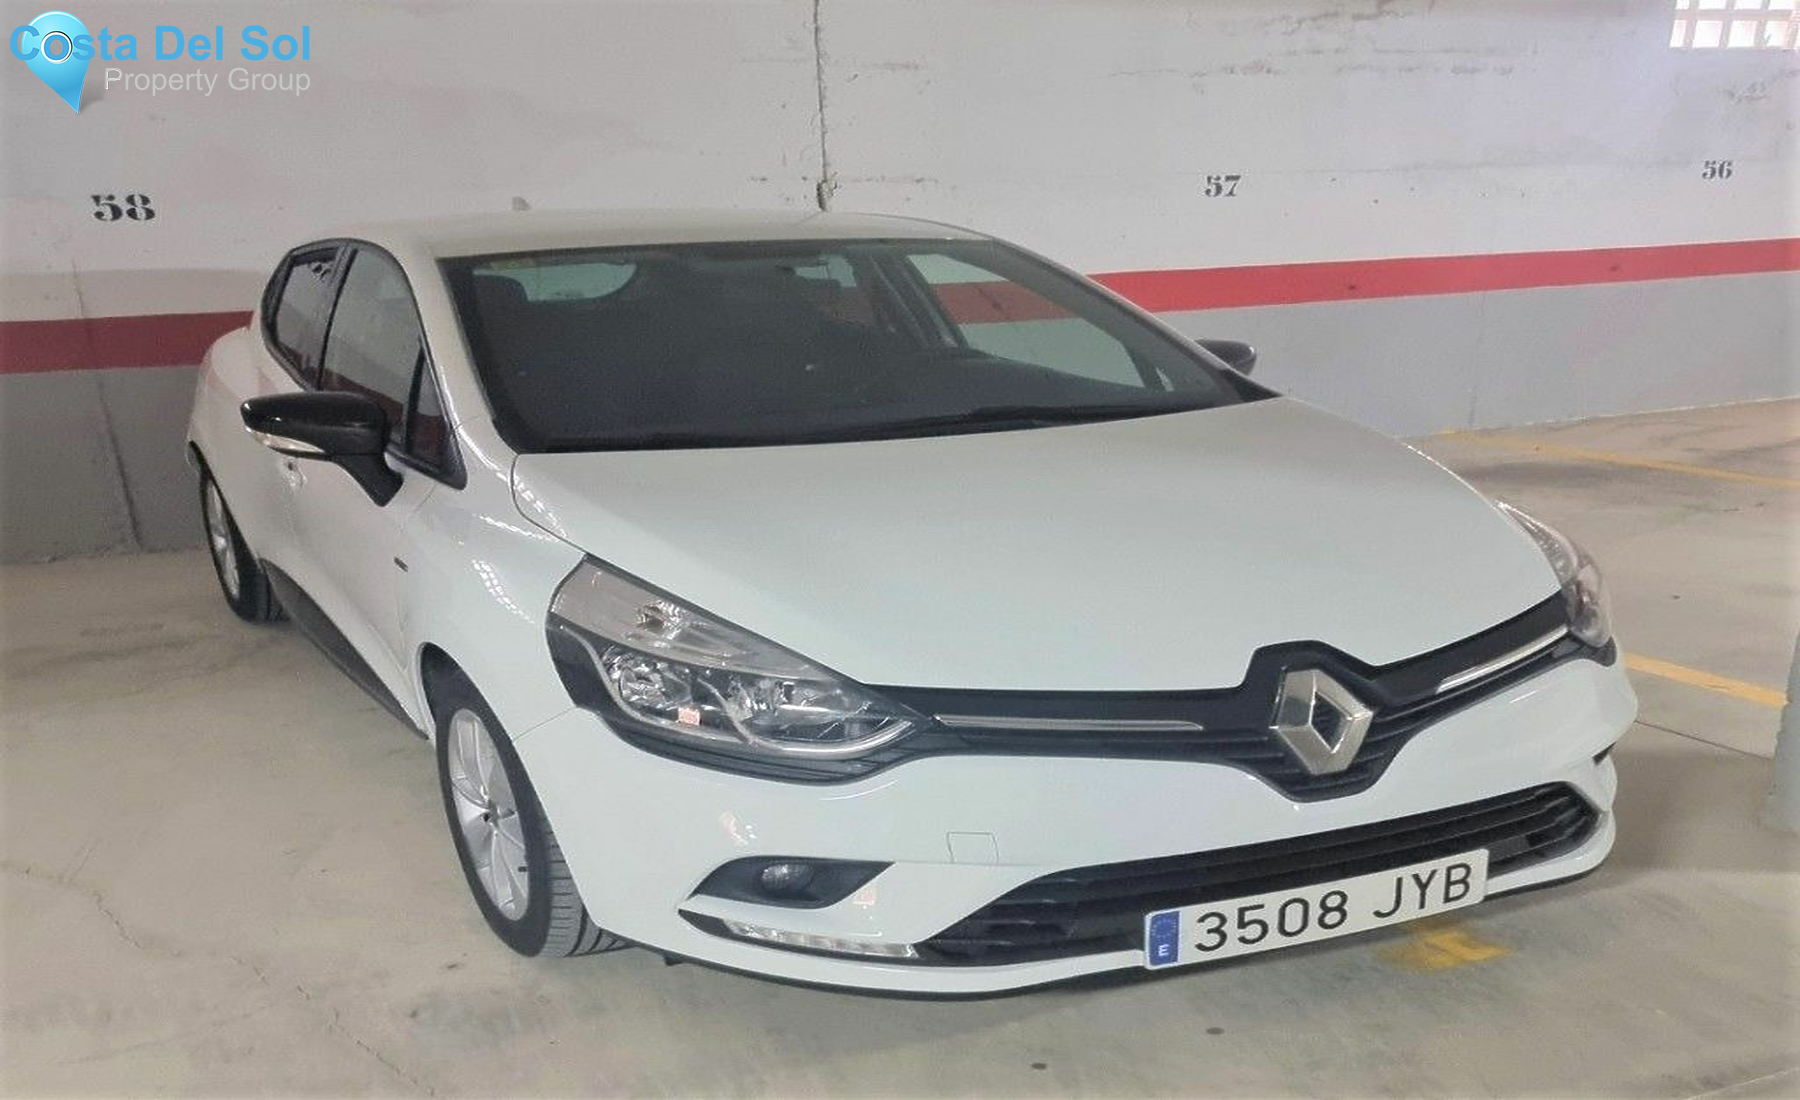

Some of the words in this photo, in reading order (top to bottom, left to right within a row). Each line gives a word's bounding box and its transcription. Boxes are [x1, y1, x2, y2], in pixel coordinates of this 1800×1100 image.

[1702, 160, 1732, 179] 56
[1205, 175, 1241, 198] 57
[91, 194, 155, 221] 58
[1158, 944, 1170, 956] E
[1194, 890, 1349, 952] 3508
[1372, 862, 1472, 918] JYB
